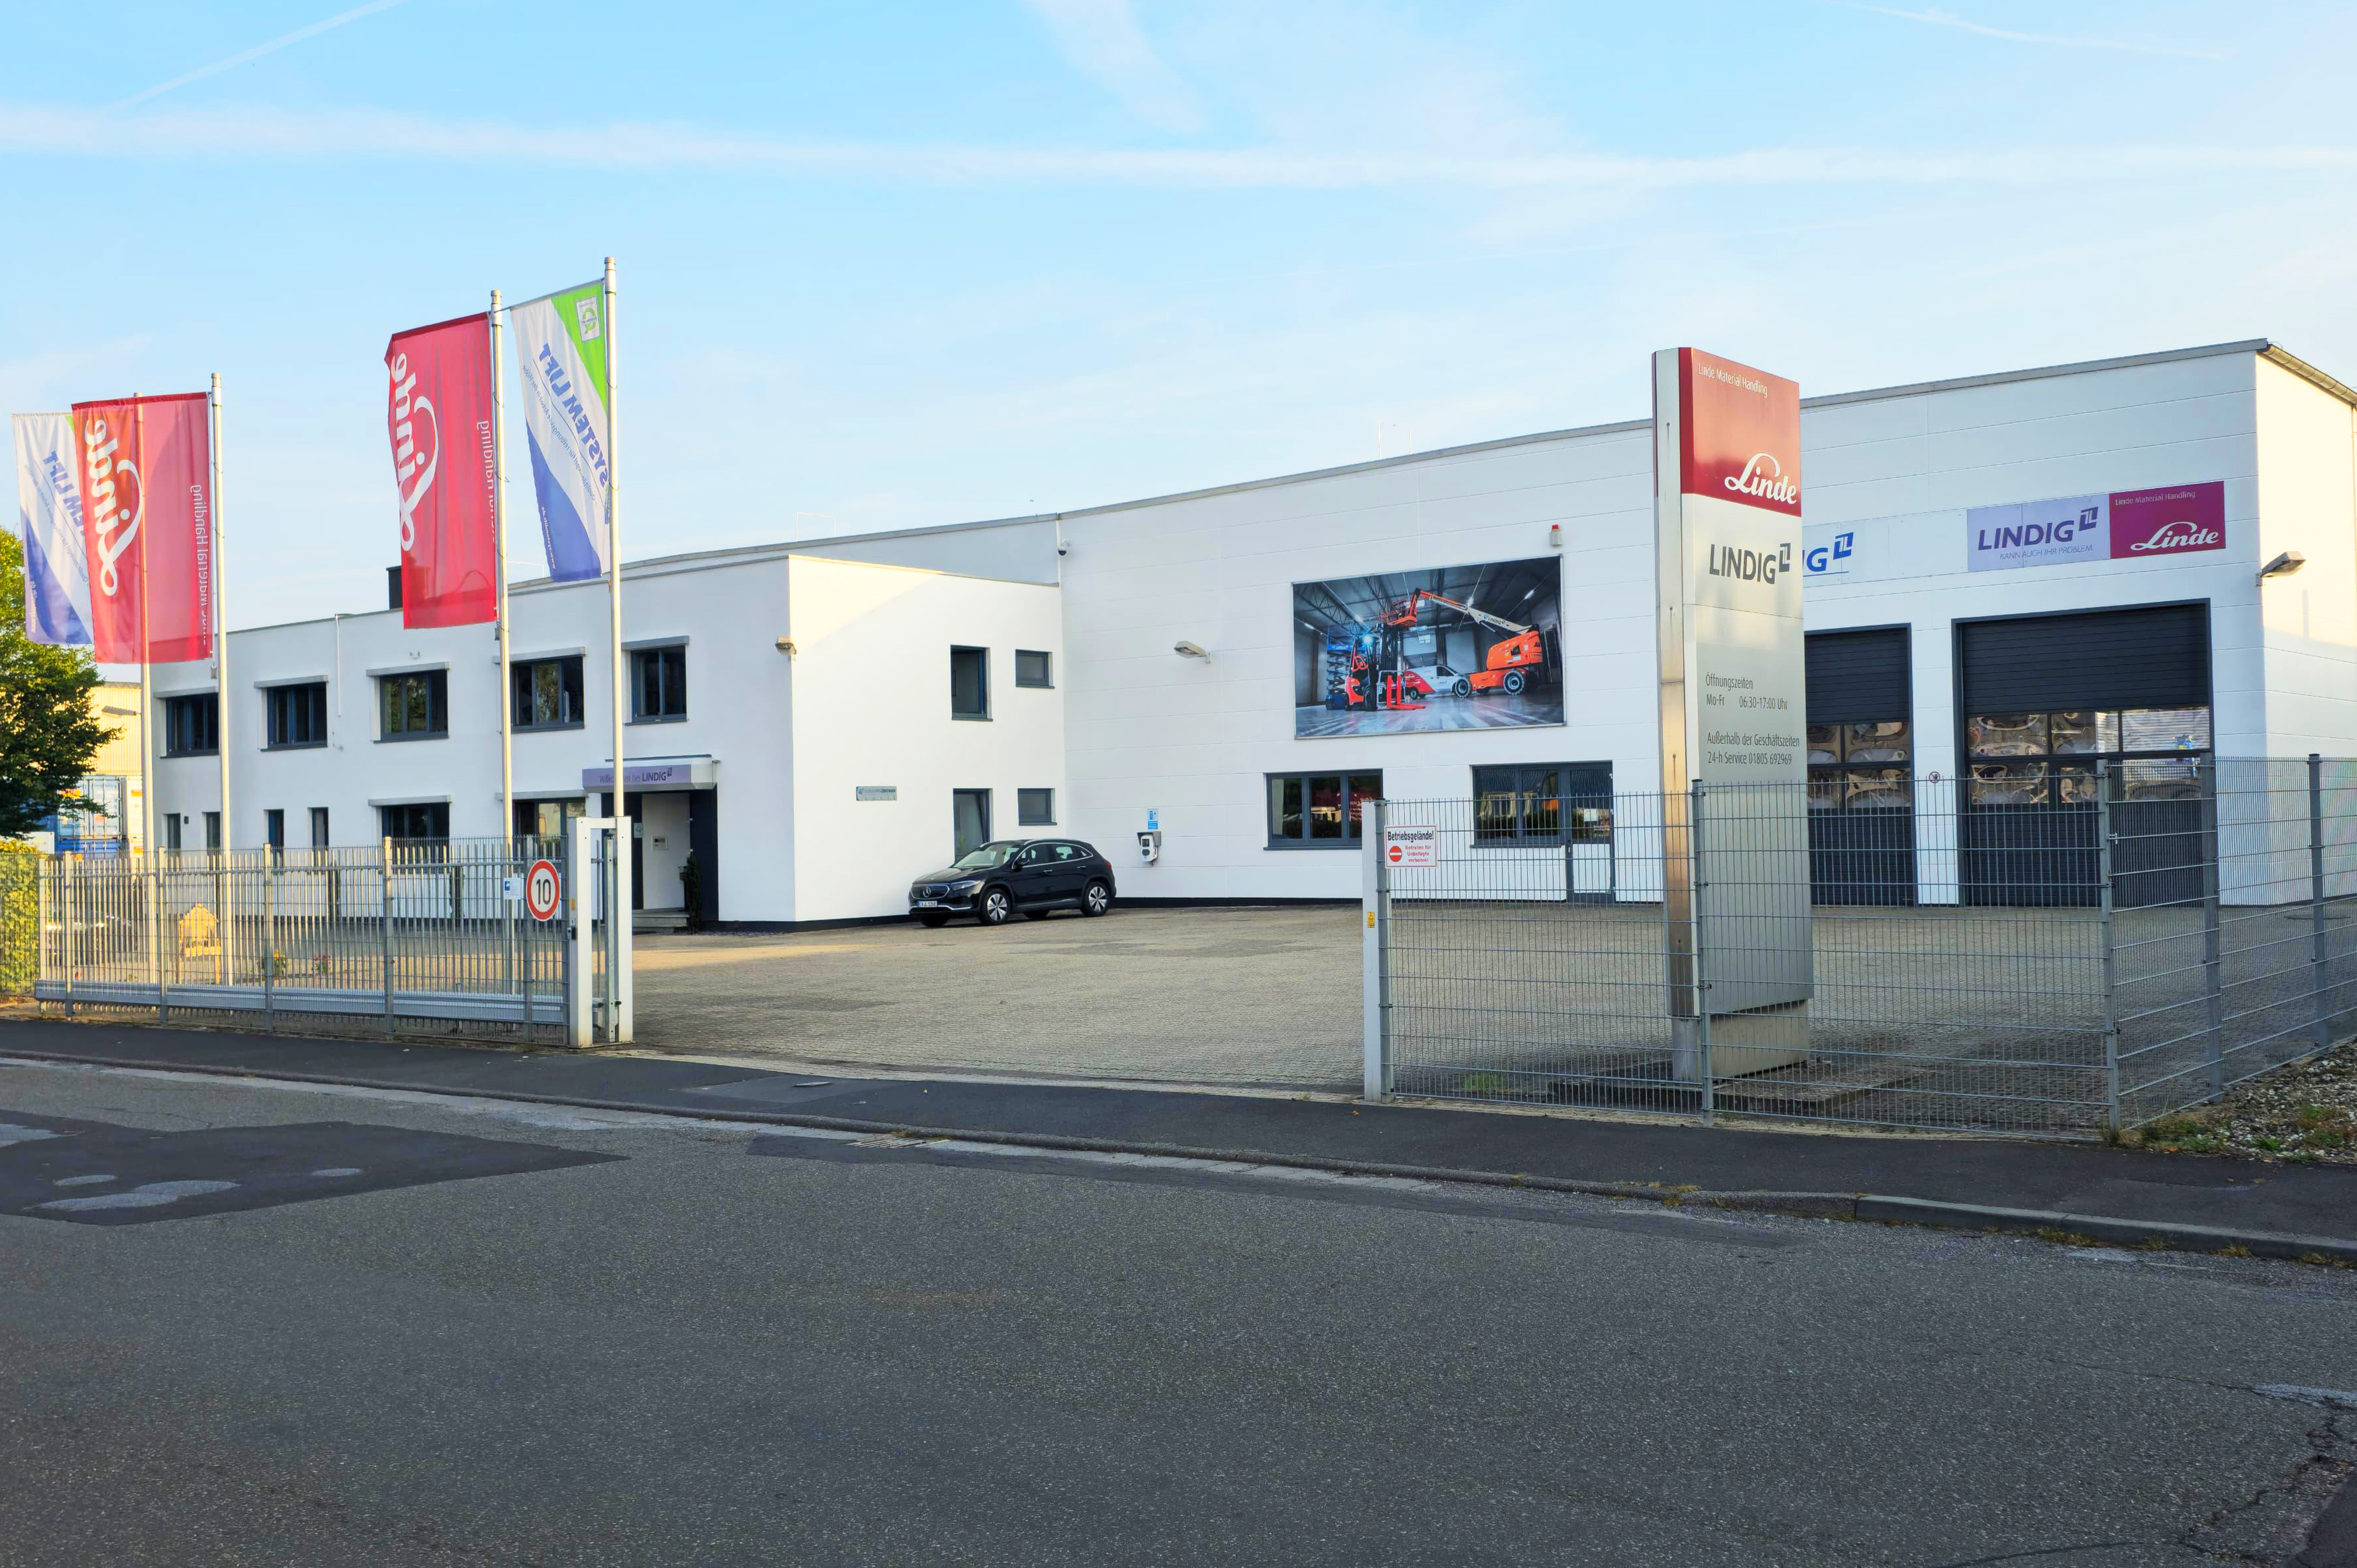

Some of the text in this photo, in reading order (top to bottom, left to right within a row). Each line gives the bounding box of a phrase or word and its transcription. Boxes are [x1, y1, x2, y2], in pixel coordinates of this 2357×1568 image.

[1699, 363, 1768, 398] Linde Material Handling
[1725, 452, 1798, 504] Linde
[2115, 491, 2196, 506] Linde Material Handling
[1978, 520, 2075, 550] LINDIG
[2130, 522, 2219, 551] Linde
[1709, 543, 1777, 585] LINDIG
[1706, 672, 1753, 691] Öffnungszeiten
[1706, 694, 1788, 710] Mo-Fr 06:30-17:00 Uhr
[1707, 731, 1800, 747] Außerhalb der Geschäftszeiten
[1707, 750, 1792, 765] 24-h Service 01805 692969
[642, 772, 666, 781] LINDIG
[1387, 830, 1434, 843] Betriebsgelände!
[536, 878, 551, 905] 10
